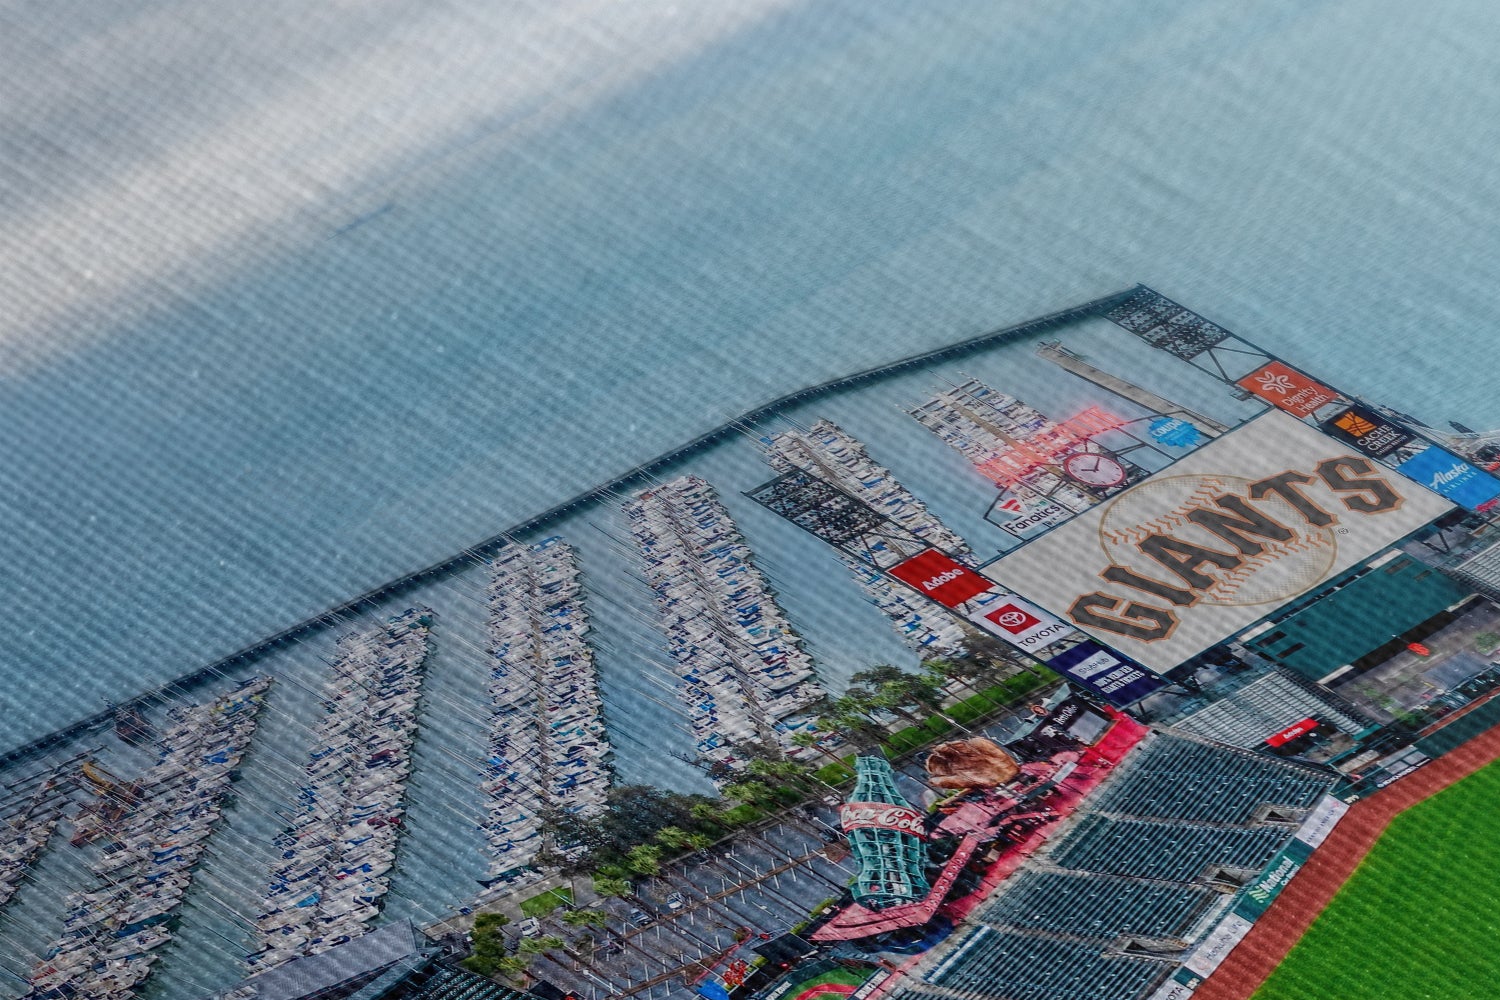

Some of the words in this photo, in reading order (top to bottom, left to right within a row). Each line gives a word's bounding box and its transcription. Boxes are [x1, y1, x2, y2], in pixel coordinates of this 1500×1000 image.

[1283, 386, 1318, 407] Dignity
[1296, 394, 1329, 413] Health
[1357, 424, 1393, 446] CACHE
[1367, 431, 1401, 451] CREEK
[1430, 463, 1470, 490] Alaska
[1004, 503, 1061, 534] Fanatics
[1066, 454, 1404, 644] GIANTS
[920, 566, 965, 591] Adobe
[1019, 622, 1068, 648] TOYOTA
[841, 808, 925, 835] Coca-Cola
[1259, 855, 1294, 893] National
